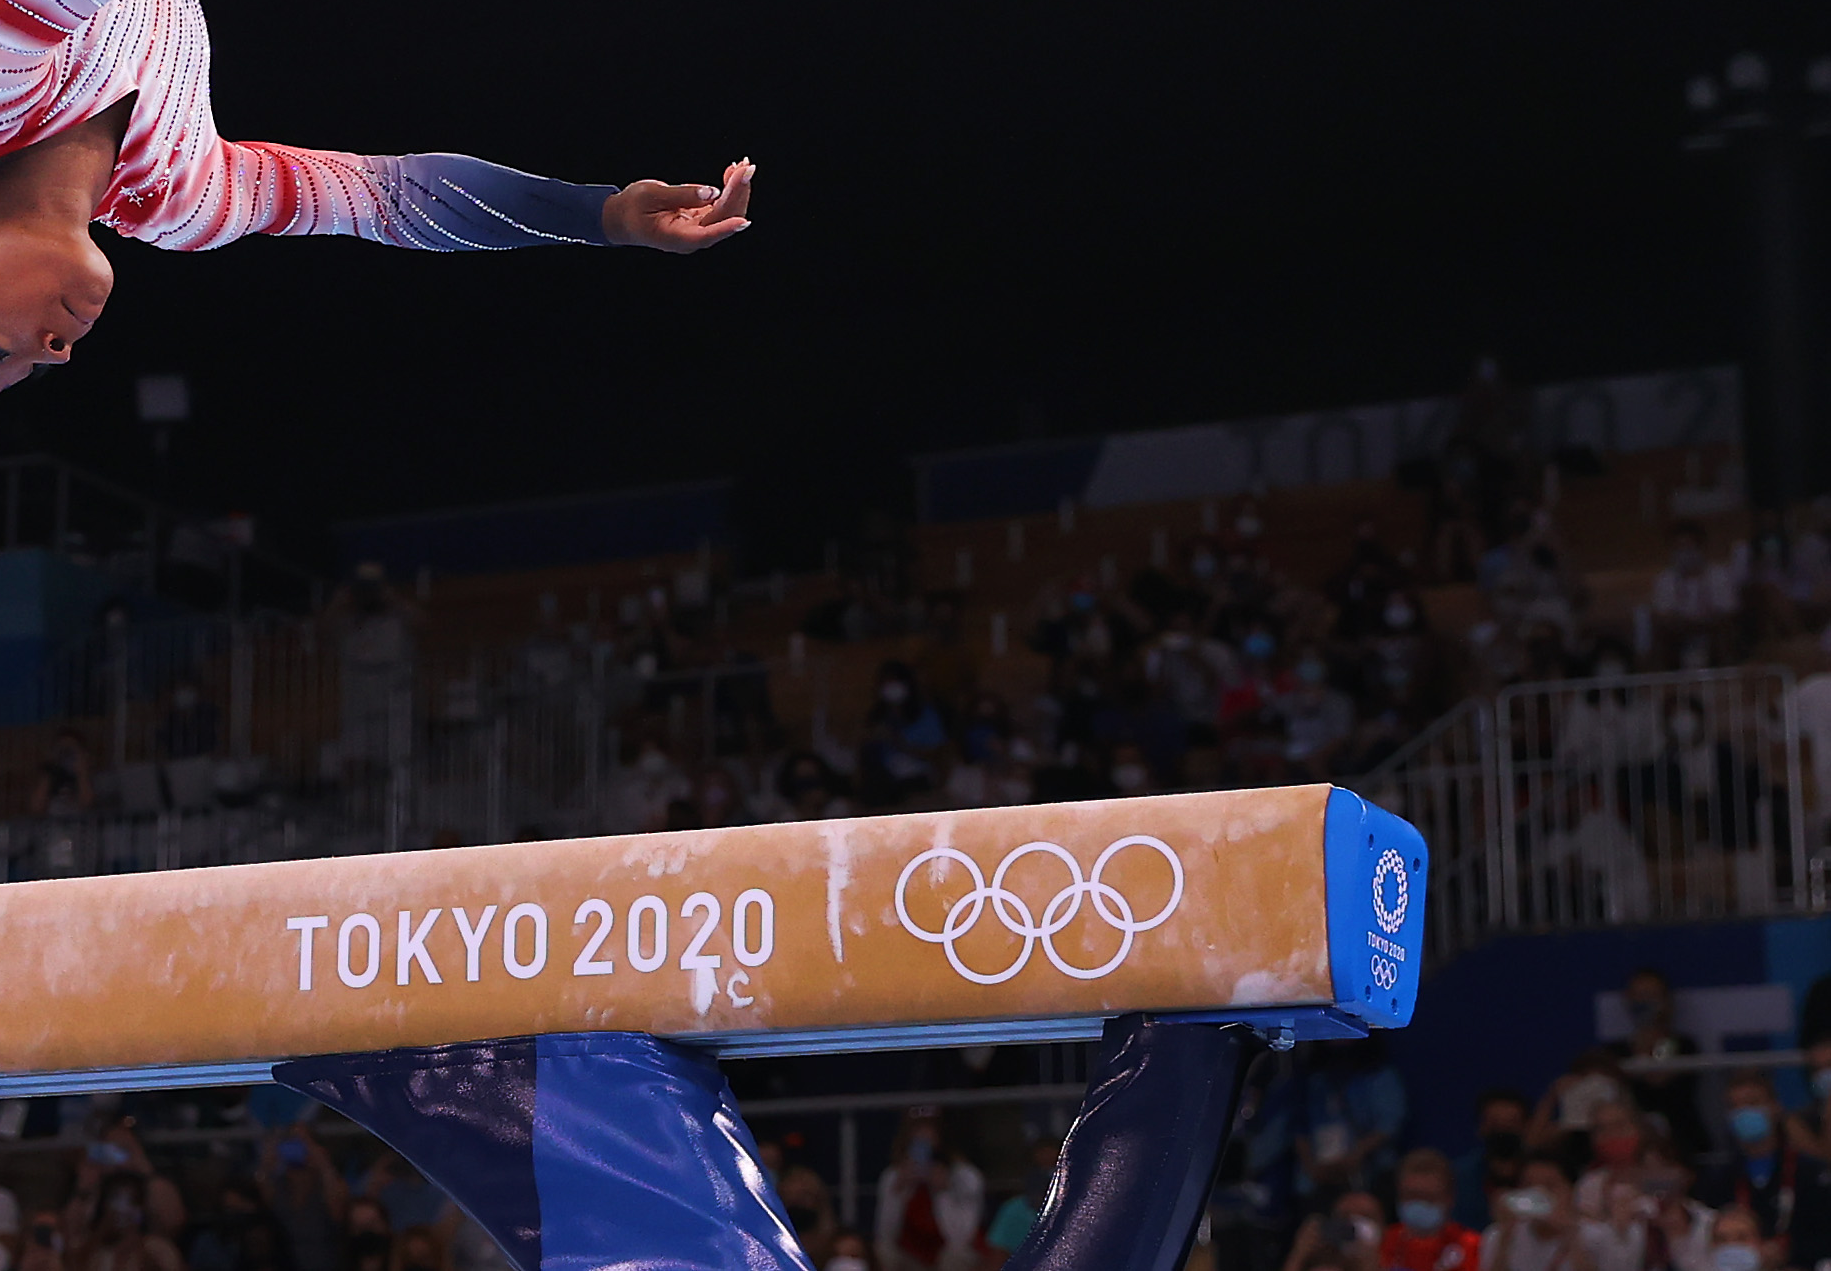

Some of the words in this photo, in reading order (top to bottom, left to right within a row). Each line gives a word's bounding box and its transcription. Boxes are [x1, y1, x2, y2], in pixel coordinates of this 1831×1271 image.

[286, 902, 549, 991] TOKYO
[572, 887, 775, 976] 2020
[1367, 930, 1389, 954] TOKYO
[1389, 942, 1405, 962] 2020
